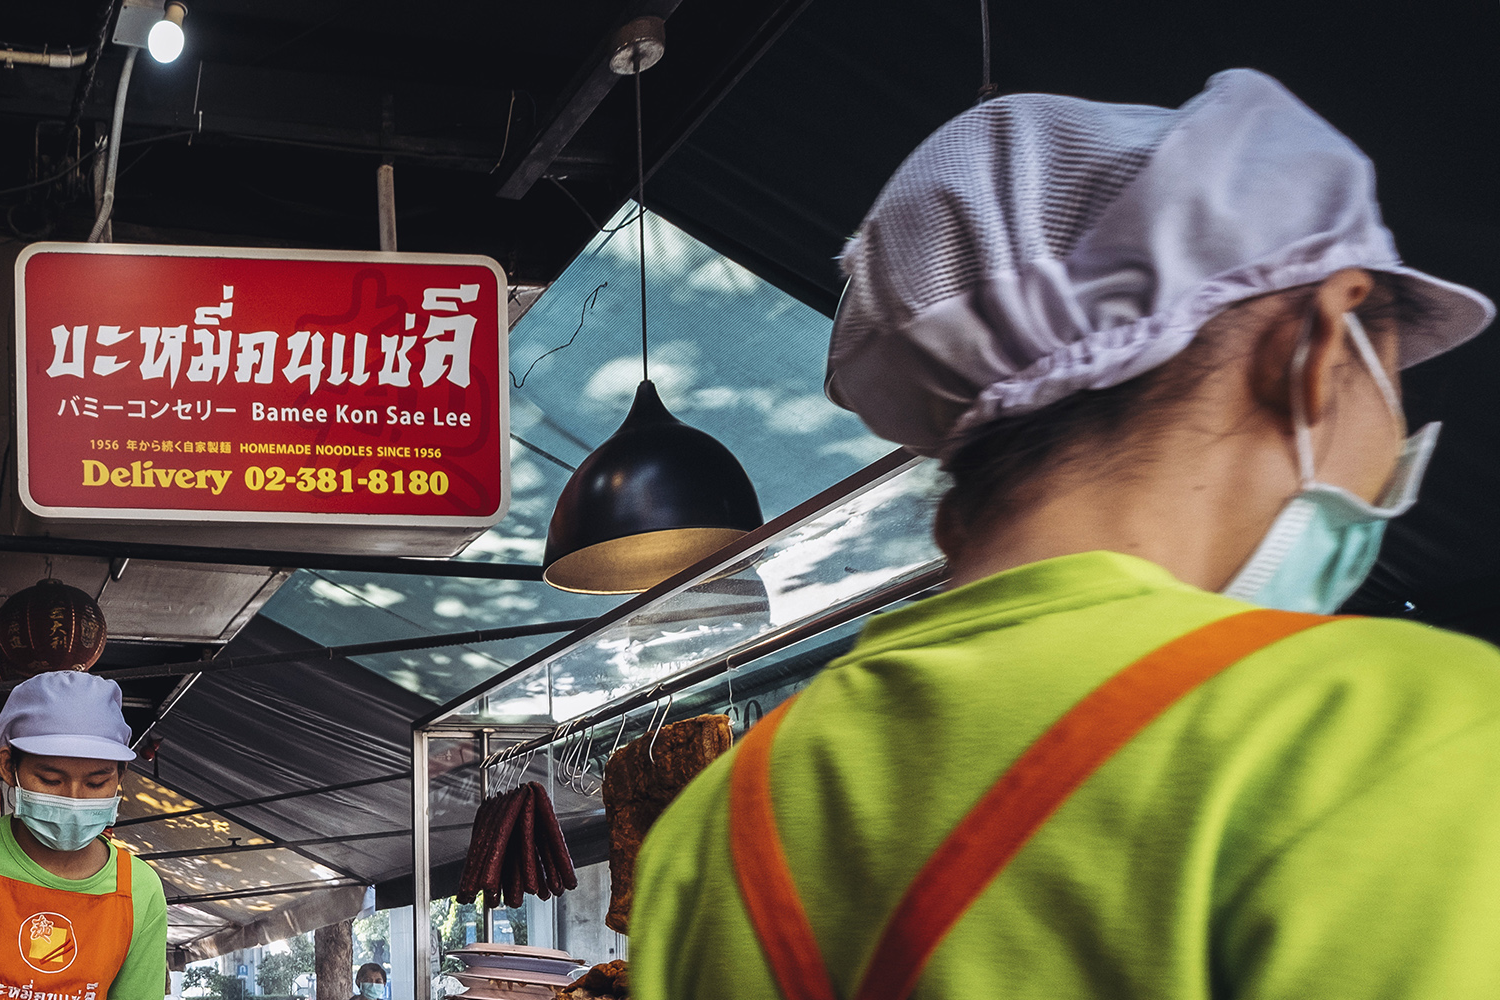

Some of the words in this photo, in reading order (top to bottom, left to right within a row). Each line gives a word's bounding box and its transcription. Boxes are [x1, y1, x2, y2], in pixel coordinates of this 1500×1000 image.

[46, 284, 480, 395] บะหมี่คนแซ่ลี
[57, 395, 237, 421] バミーコンセリー
[252, 402, 328, 423] Bamee
[336, 404, 378, 424] Kon
[386, 406, 425, 426] Sae
[433, 407, 471, 427] Lee
[90, 439, 119, 450] 1956
[240, 443, 311, 455] HOMEMADE
[316, 445, 373, 457] NOODLES
[377, 446, 411, 458] SINCE
[414, 448, 442, 459] 1956
[82, 459, 233, 495] Delivery
[244, 466, 449, 495] 02-381-8180
